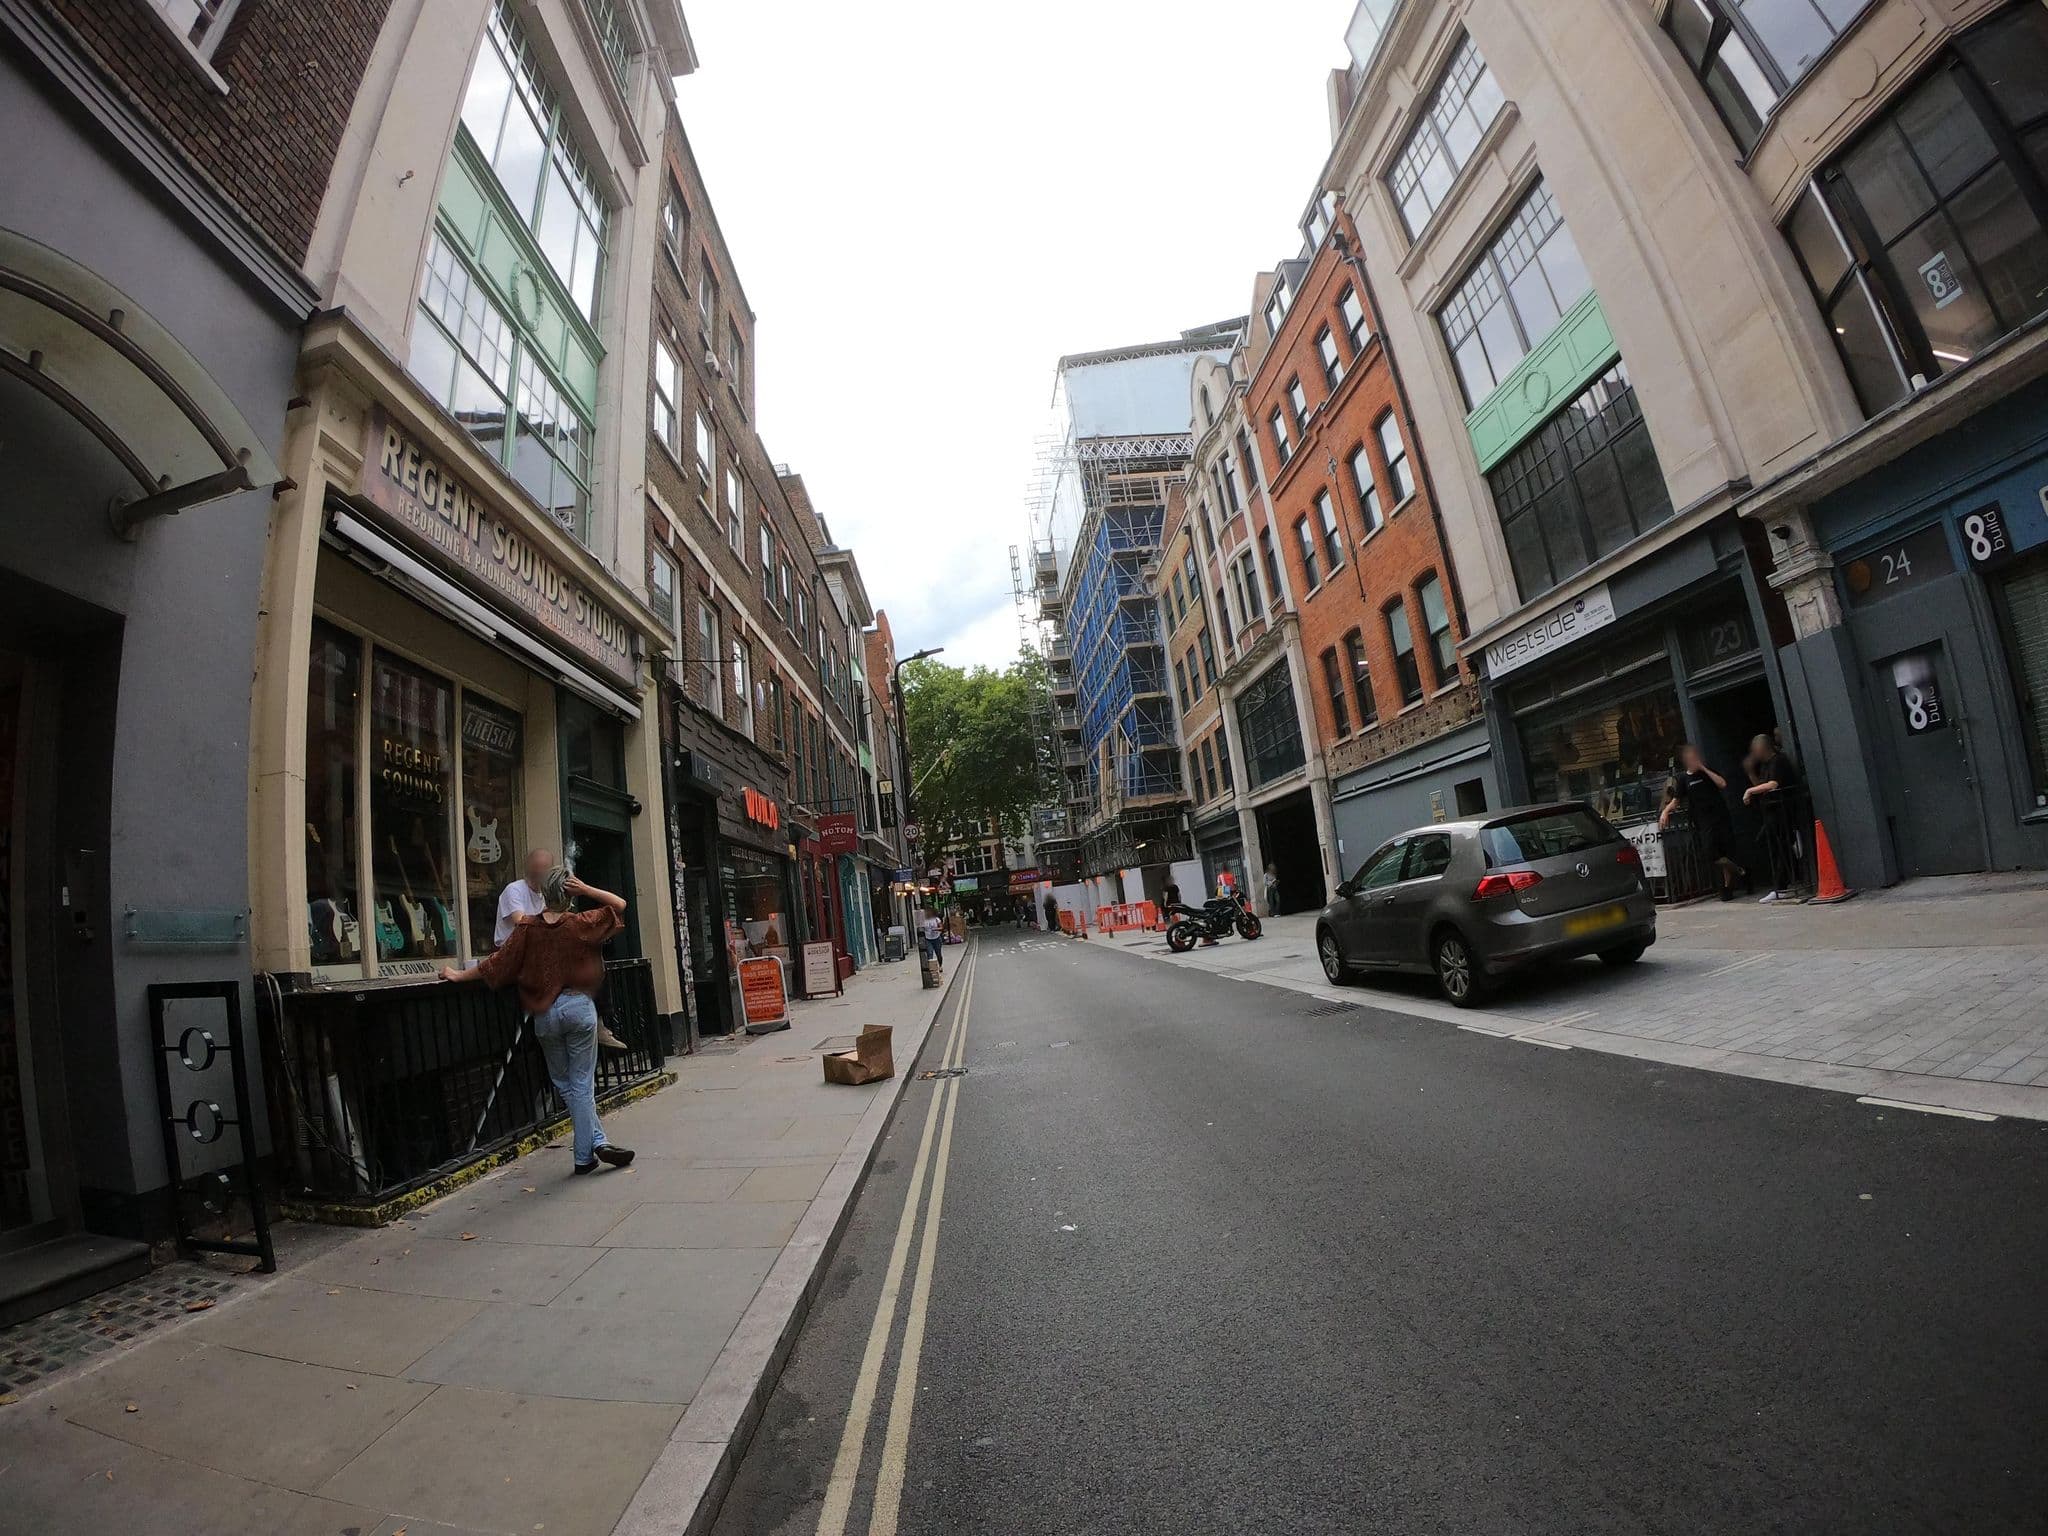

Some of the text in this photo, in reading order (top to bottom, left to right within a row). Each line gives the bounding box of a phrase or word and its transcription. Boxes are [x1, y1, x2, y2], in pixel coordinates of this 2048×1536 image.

[1927, 269, 1947, 298] 8
[381, 424, 628, 657] REGENT SOUNDS STUDIO
[1965, 515, 1991, 561] 8
[1983, 510, 2006, 552] build
[398, 497, 461, 556] RECORDING
[463, 545, 472, 563] &
[475, 552, 542, 614] PHONOGRAPHIC
[1880, 548, 1912, 585] 24
[1487, 612, 1577, 667] Westside
[1710, 621, 1741, 656] 23
[383, 739, 441, 775] REGENT
[382, 769, 442, 804] SOUNDS
[906, 828, 918, 836] 20
[400, 961, 435, 976] SOUNDS
